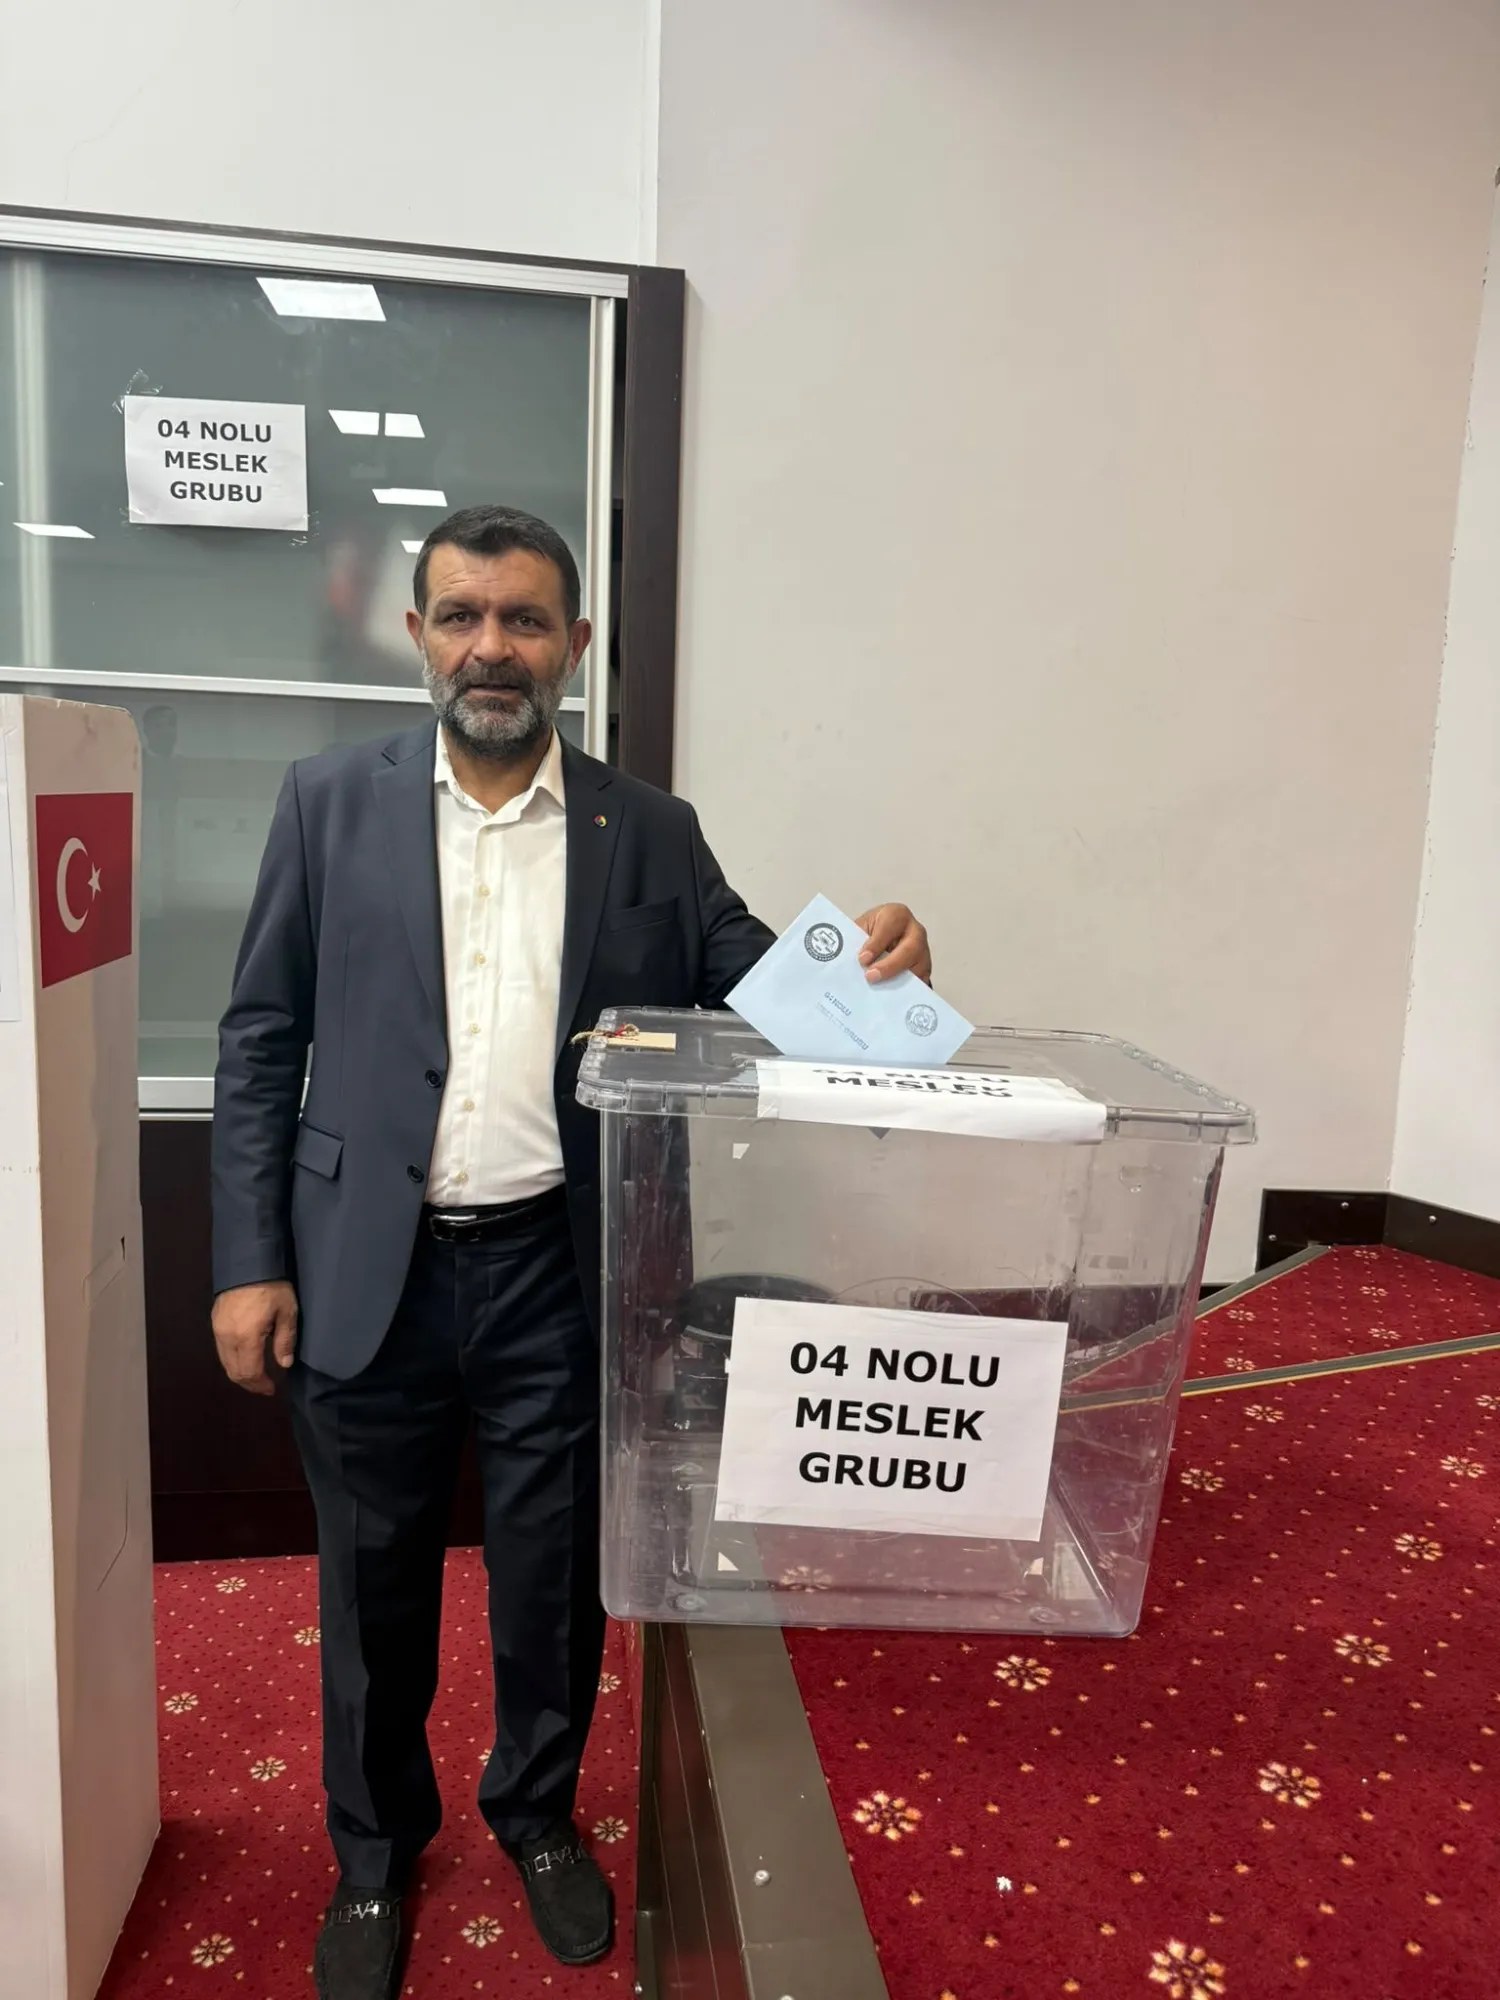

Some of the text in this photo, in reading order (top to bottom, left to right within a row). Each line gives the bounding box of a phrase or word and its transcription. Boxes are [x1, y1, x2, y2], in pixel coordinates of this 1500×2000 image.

[158, 419, 271, 443] 04 NOLU
[165, 450, 268, 474] MESLEK
[170, 481, 262, 503] GRUBU
[826, 1076, 1008, 1093] MESLEK
[790, 1342, 1001, 1387] 04 NOLU
[795, 1396, 985, 1441] MESLEK
[798, 1451, 968, 1494] GRUBU
